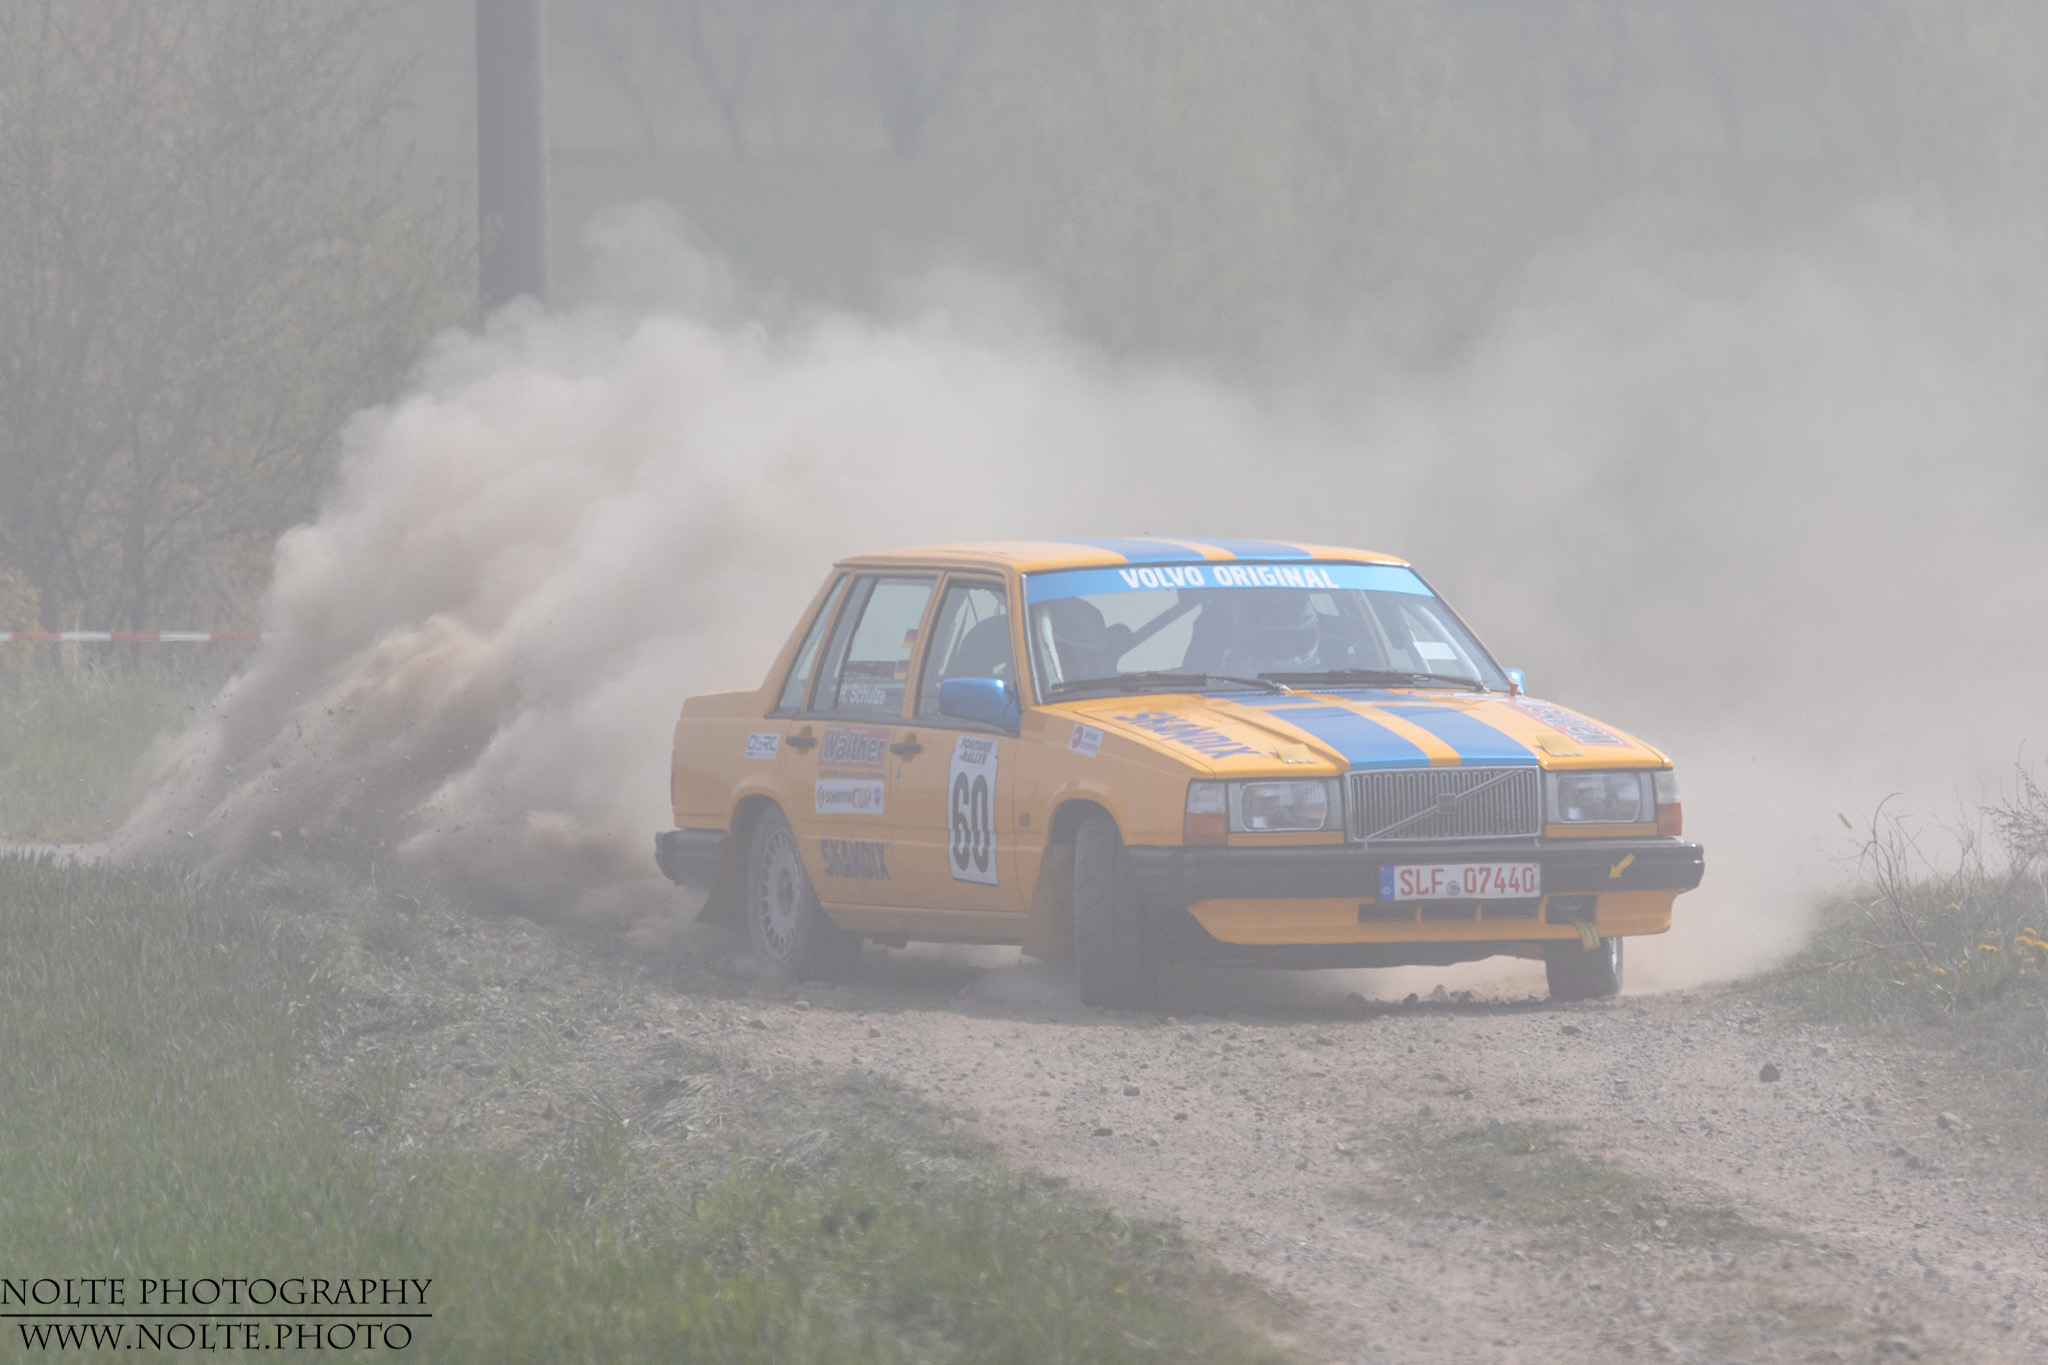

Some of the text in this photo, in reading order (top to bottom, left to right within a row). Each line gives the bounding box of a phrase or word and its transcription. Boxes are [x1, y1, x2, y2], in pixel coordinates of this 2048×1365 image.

[1119, 566, 1339, 589] VOLVO ORIGINAL
[823, 726, 888, 764] Walther
[1113, 711, 1262, 759] SKANDIX
[952, 771, 989, 873] 60
[821, 838, 892, 881] SKANDIX
[1400, 867, 1535, 896] SLF 07440
